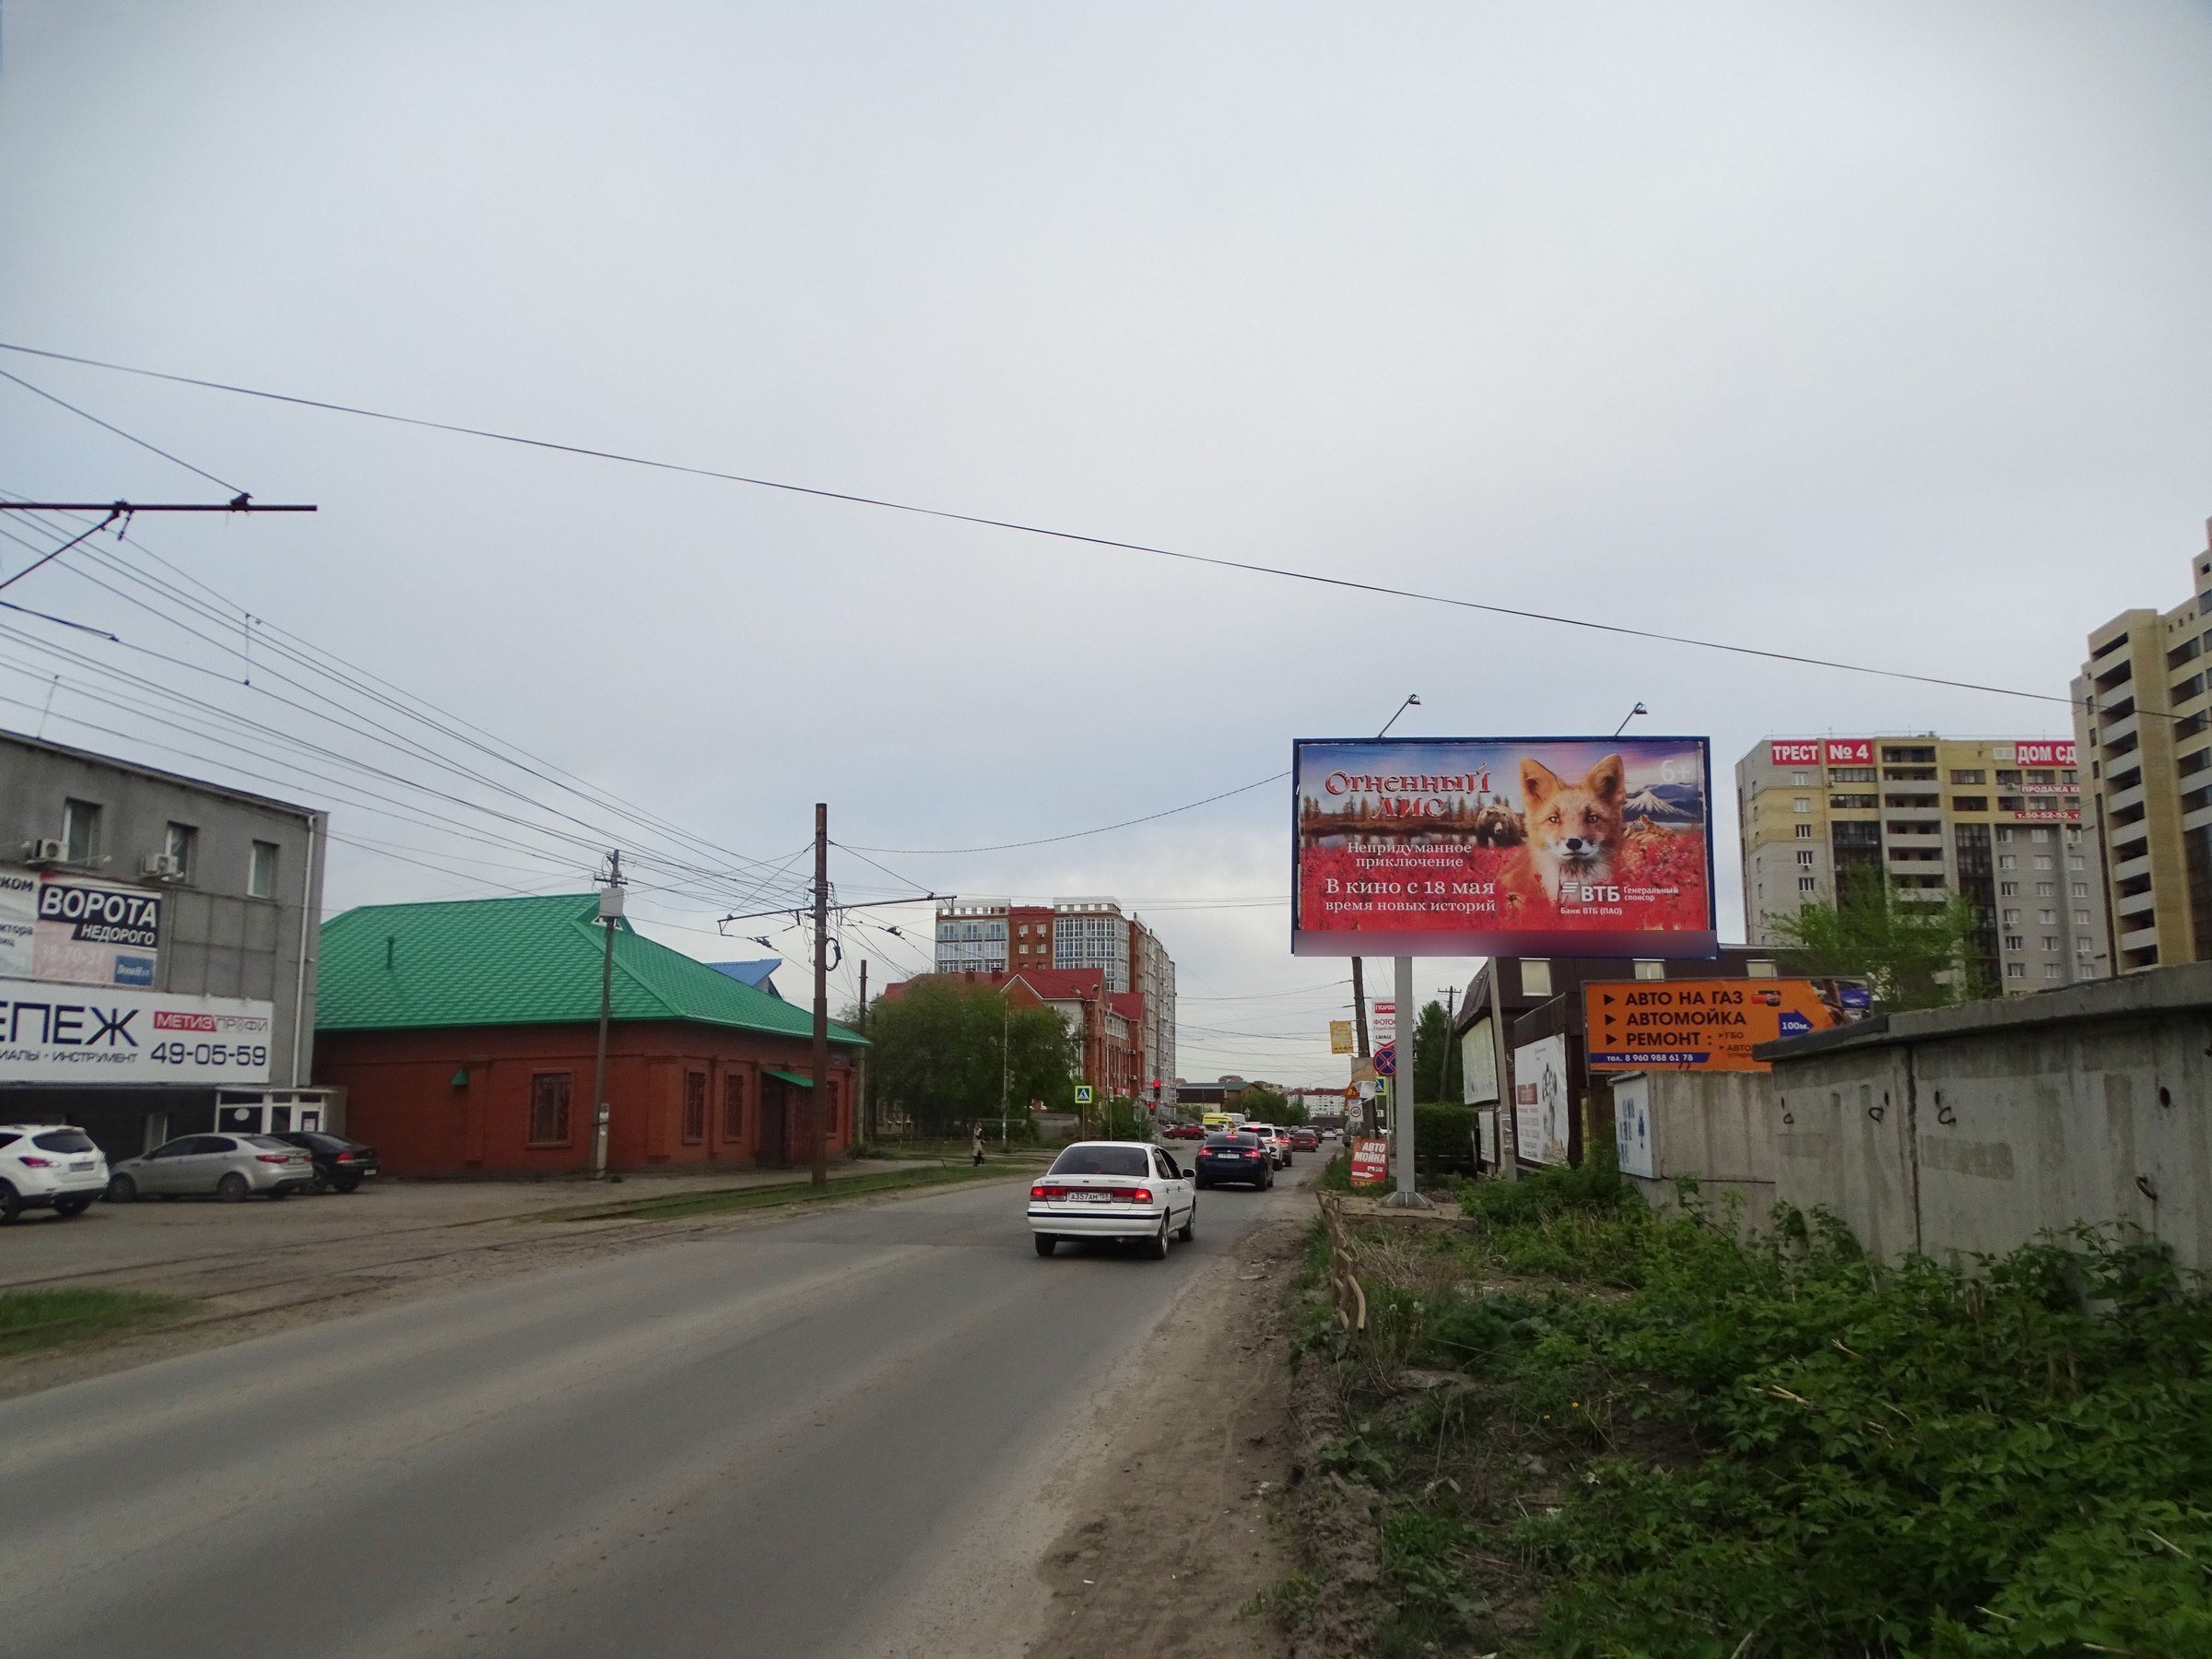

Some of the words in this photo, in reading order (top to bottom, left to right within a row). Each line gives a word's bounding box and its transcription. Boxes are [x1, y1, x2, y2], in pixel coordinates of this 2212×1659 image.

[1772, 745, 1818, 760] ТРЕСТ
[1829, 744, 1853, 759] №
[1856, 744, 1868, 759] 4
[2018, 746, 2052, 764] ДОМ
[1661, 759, 1691, 782] 6+
[1325, 762, 1490, 794] Огненный
[2021, 785, 2067, 794] ПРОДАЖА
[1347, 841, 1472, 855] Непридуманное
[1356, 857, 1464, 868] приключение
[1325, 878, 1339, 894] В
[1347, 882, 1401, 894] кино
[1407, 882, 1418, 894] с
[1424, 881, 1445, 894] 18
[1453, 882, 1495, 894] мая
[1623, 886, 1679, 895] Генеральный
[1581, 886, 1620, 902] ВТБ
[41, 887, 157, 928] ВОРОТА
[1325, 901, 1372, 914] время
[1378, 901, 1427, 912] новых
[1430, 900, 1496, 914] историй
[1600, 907, 1622, 915] (ПАО)
[80, 924, 155, 946] НЕДОРОГО
[1625, 992, 1673, 1006] АВТО
[1678, 992, 1705, 1005] НА
[1712, 991, 1744, 1005] ГАЗ
[1626, 1008, 1747, 1026] АВТОМОЙКА
[1626, 1032, 1700, 1046] РЕМОНТ
[52, 1051, 138, 1064] ИНСТРУМЕНТ
[150, 1042, 266, 1066] 49-05-59
[1625, 1053, 1630, 1062] 8
[1632, 1053, 1649, 1062] 960
[1651, 1053, 1666, 1061] 988
[1669, 1053, 1679, 1061] 61
[1682, 1052, 1693, 1061] 78
[1362, 1142, 1385, 1152] АВТО
[1354, 1151, 1386, 1163] МОЙКА
